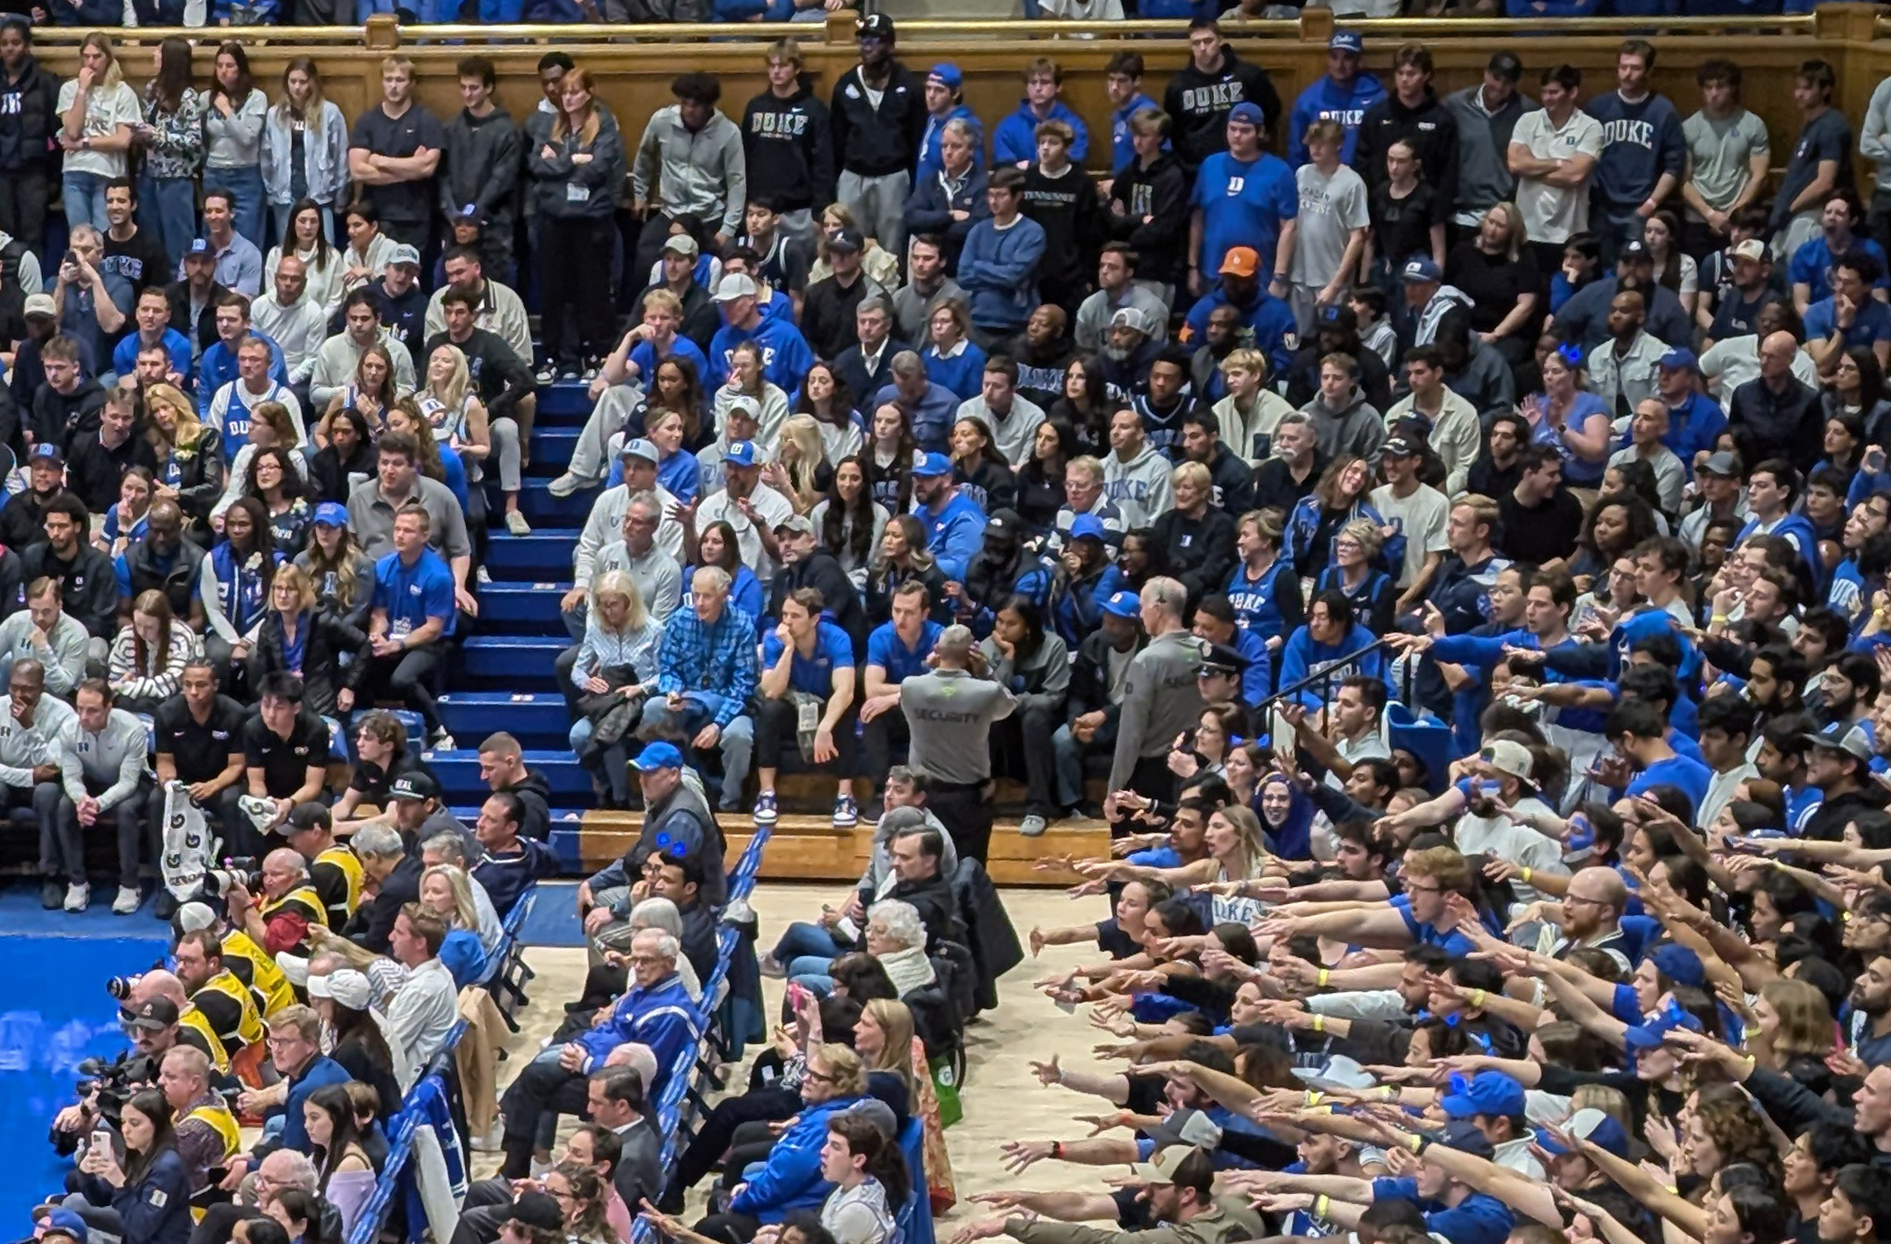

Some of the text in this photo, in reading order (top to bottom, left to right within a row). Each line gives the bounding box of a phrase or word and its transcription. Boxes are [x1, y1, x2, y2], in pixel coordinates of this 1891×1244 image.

[1182, 82, 1244, 112] DUKE
[752, 112, 809, 134] DUKE
[1604, 120, 1653, 150] DUKE
[914, 708, 980, 726] SECURITY
